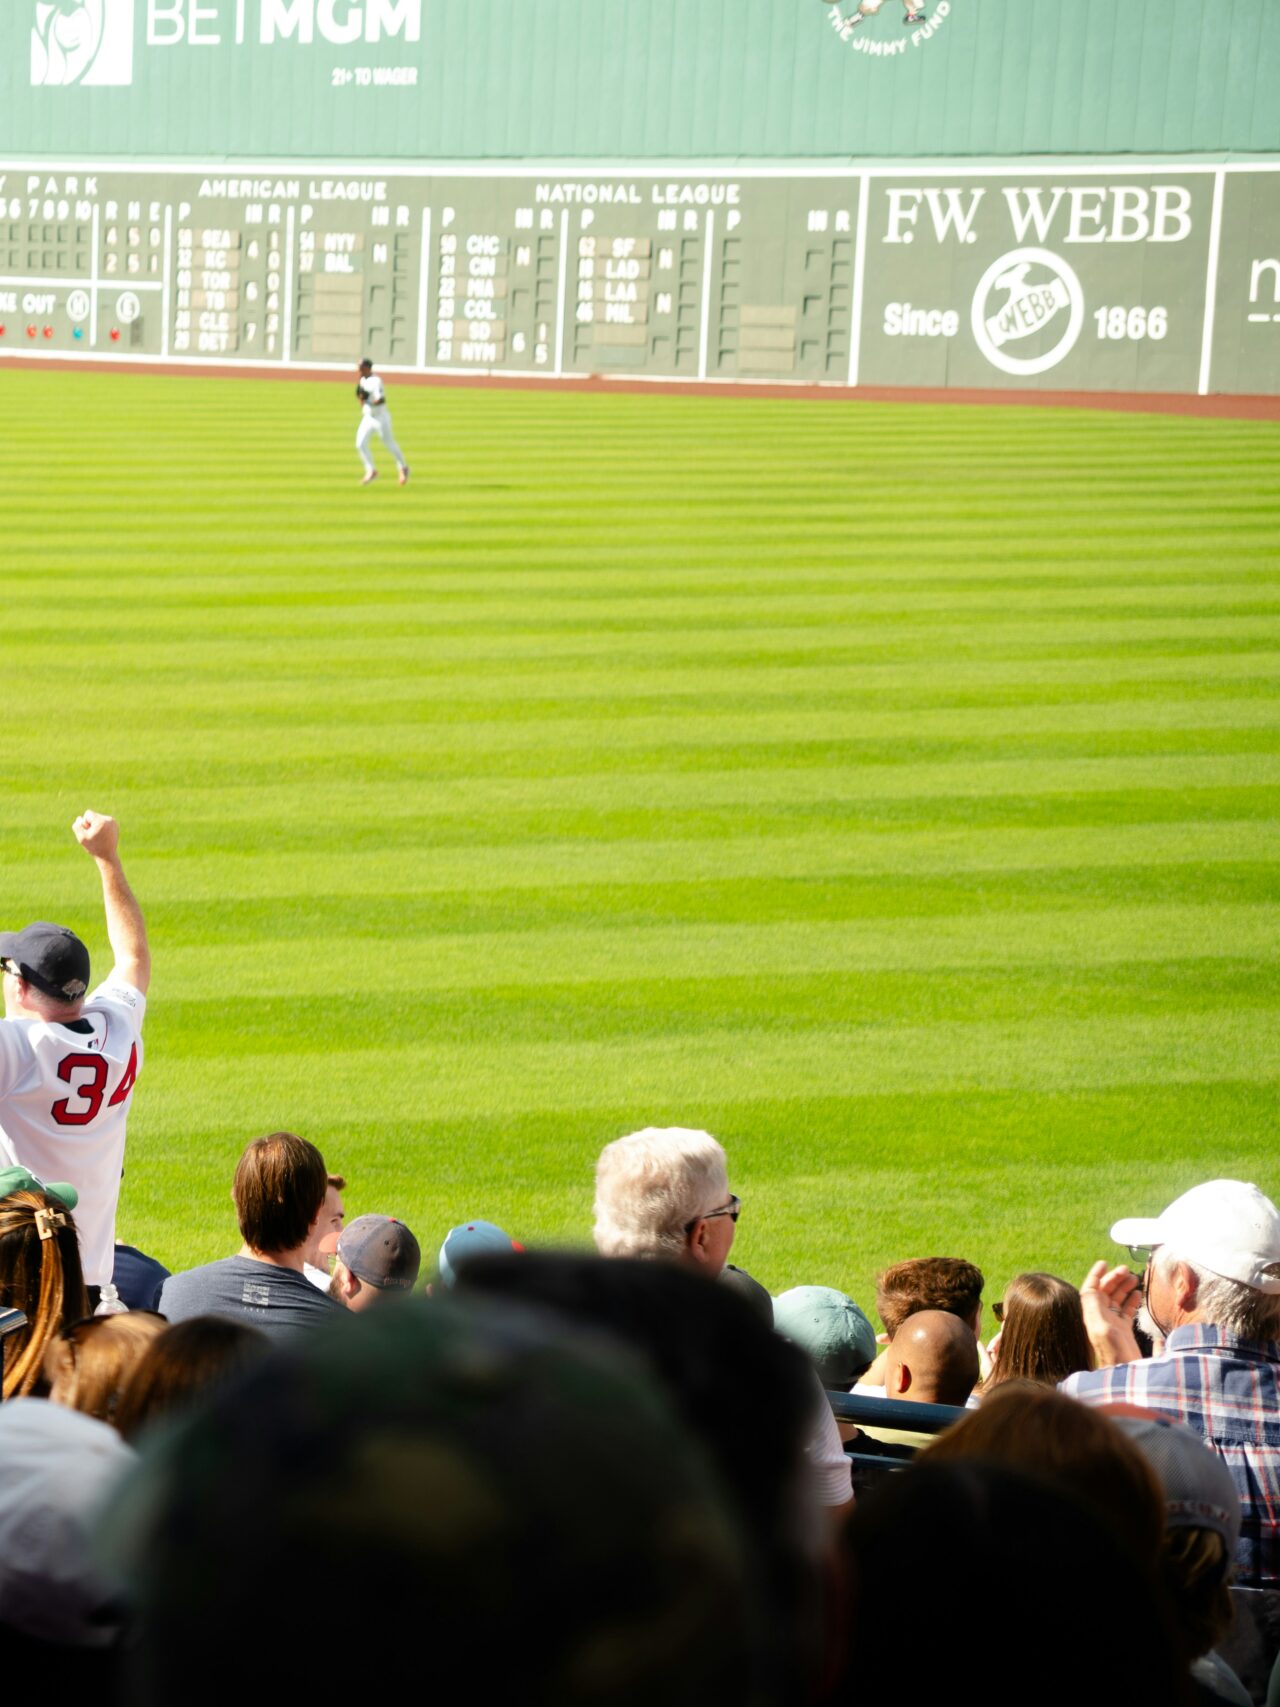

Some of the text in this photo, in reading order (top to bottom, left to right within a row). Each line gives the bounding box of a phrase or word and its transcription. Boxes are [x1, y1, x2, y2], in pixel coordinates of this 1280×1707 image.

[828, 1, 950, 56] THE JIMMY FUND
[355, 69, 371, 86] TO
[373, 68, 417, 86] WAGER
[27, 176, 98, 196] PARK
[198, 179, 387, 201] AMERICAN LEAGUE
[536, 184, 740, 204] NATIONAL LEAGUE
[9, 198, 21, 219] 6
[29, 198, 39, 219] 7
[43, 199, 54, 220] 8
[57, 200, 69, 220] 9
[75, 200, 91, 221] 10
[106, 200, 118, 221] R
[128, 201, 140, 221] H
[150, 201, 160, 222] E
[179, 202, 281, 224] P IN R
[301, 205, 409, 226] P IN R
[442, 207, 553, 229] P IN R
[581, 208, 698, 230] P IN R
[726, 209, 850, 231] P IN R
[1002, 185, 1192, 243] WEBB
[107, 226, 117, 245] 4
[150, 228, 160, 247] 0
[201, 230, 231, 249] SEA
[271, 232, 278, 250] 1
[324, 233, 356, 251] NYY
[466, 235, 500, 255] CHC
[247, 240, 258, 259] 4
[373, 244, 387, 263] N
[517, 246, 531, 266] N
[612, 238, 635, 258] SF
[659, 248, 672, 269] N
[106, 253, 117, 273] 2
[151, 254, 158, 274] 1
[204, 250, 226, 269] KC
[268, 251, 280, 270] 0
[325, 253, 354, 273] BAL
[469, 257, 495, 277] CIN
[606, 259, 640, 280] LAD
[201, 270, 231, 289] TOR
[267, 271, 280, 290] 0
[467, 278, 495, 298] MIA
[206, 291, 226, 310] TB
[268, 292, 279, 310] 4
[246, 281, 257, 301] 6
[605, 281, 637, 302] LAA
[23, 294, 56, 314] OUT
[464, 299, 496, 320] COL
[606, 302, 635, 323] MIL
[656, 292, 671, 313] N
[998, 289, 1056, 333] WEBB
[199, 312, 230, 331] CLE
[883, 302, 959, 336] Since
[1094, 306, 1168, 340] 1866
[246, 322, 256, 342] 7
[468, 321, 491, 341] SD
[539, 323, 546, 342] 1
[513, 332, 525, 352] 6
[198, 332, 229, 351] DET
[268, 334, 275, 353] 1
[461, 342, 496, 362] NYM
[535, 344, 547, 364] 5
[51, 1041, 137, 1125] 34
